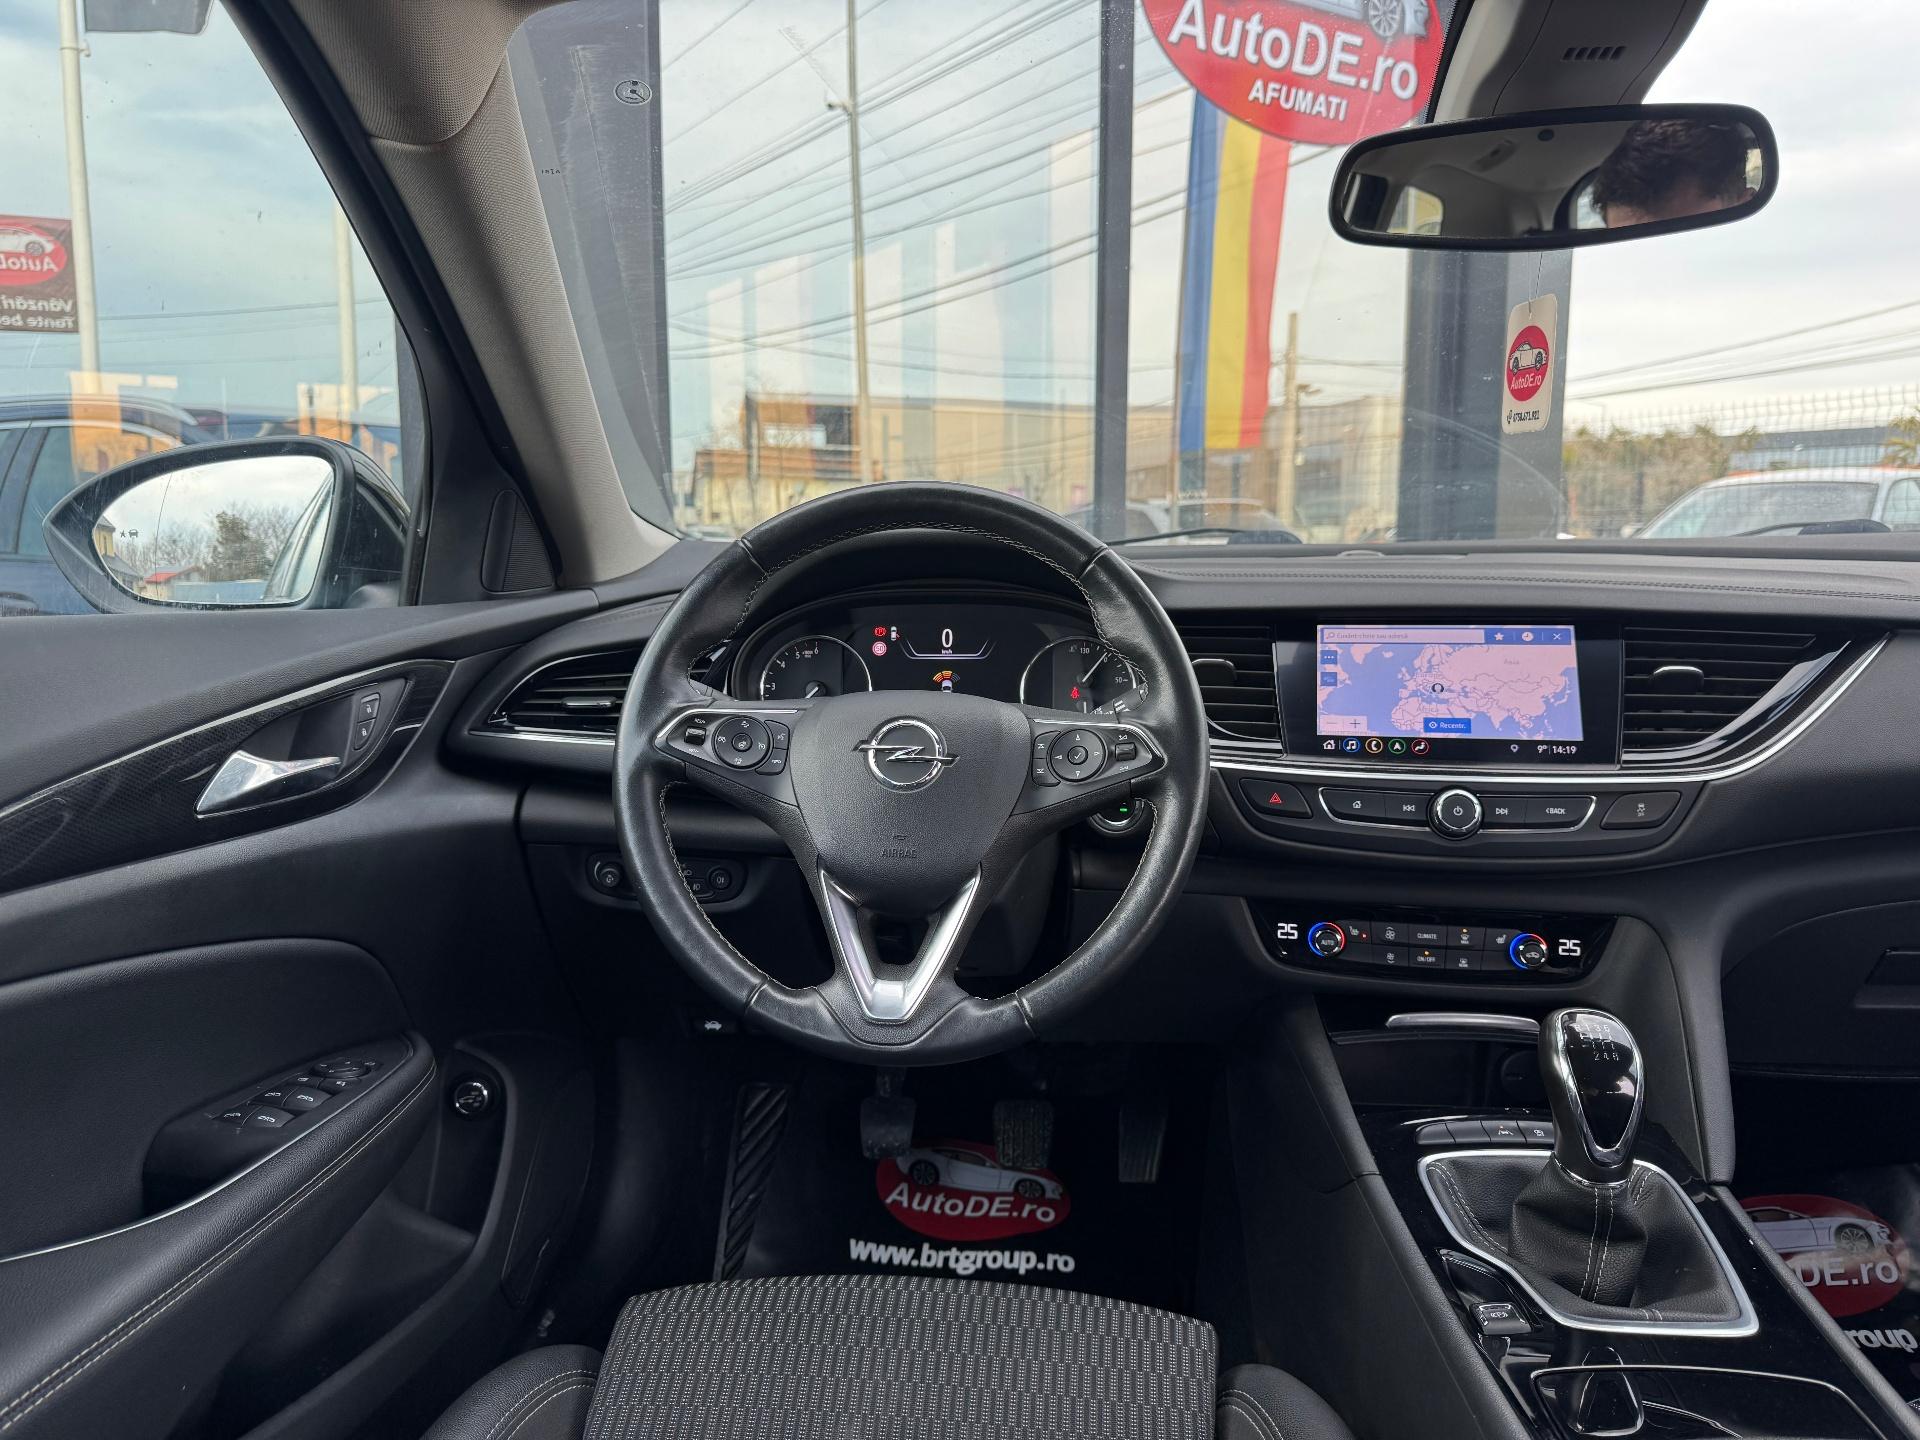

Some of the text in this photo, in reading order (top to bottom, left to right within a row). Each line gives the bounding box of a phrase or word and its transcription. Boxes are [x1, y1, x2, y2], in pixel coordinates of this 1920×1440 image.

[1167, 0, 1419, 101] AutoDE.ro
[1248, 79, 1348, 122] AFUMATI
[1511, 373, 1542, 390] AutoDE.ro
[941, 628, 953, 648] 0
[1552, 745, 1577, 754] 14:19
[1277, 922, 1299, 940] 25
[1558, 939, 1581, 956] 25
[885, 1182, 1056, 1223] AutoDE.ro
[849, 1238, 1076, 1276] www.brtgroup.ro
